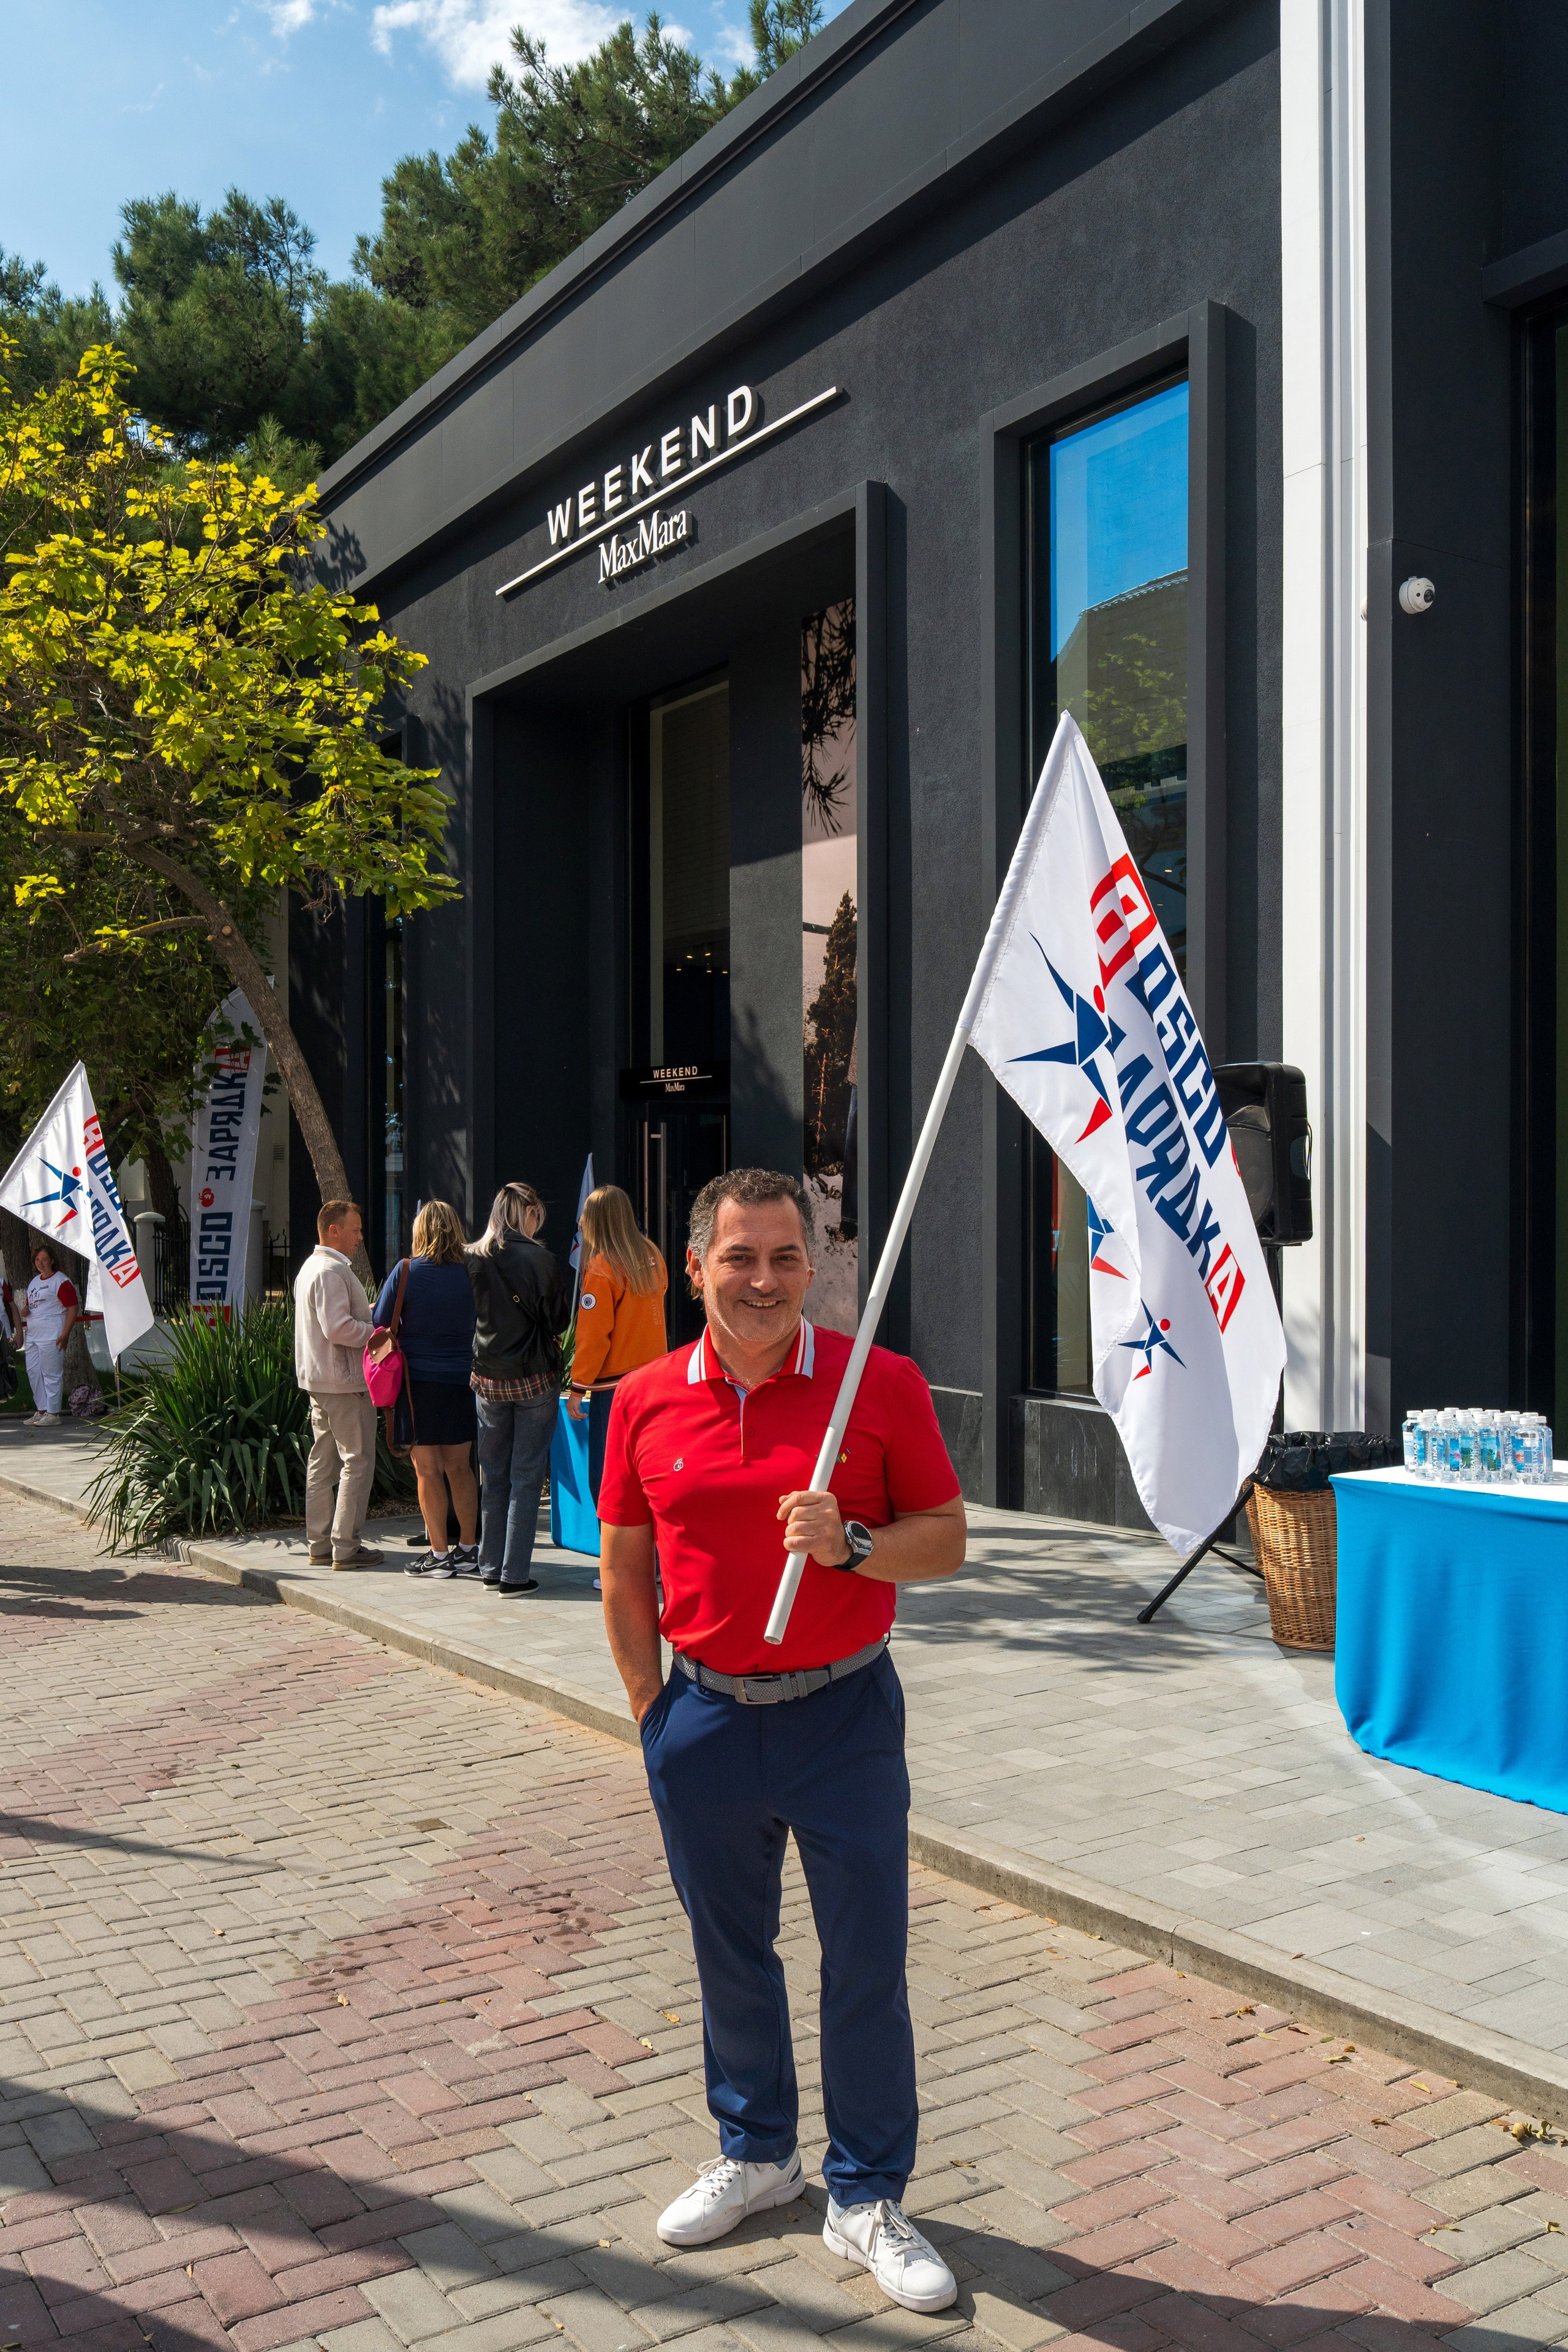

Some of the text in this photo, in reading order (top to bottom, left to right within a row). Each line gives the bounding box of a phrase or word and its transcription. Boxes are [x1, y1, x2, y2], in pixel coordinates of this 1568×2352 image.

[546, 385, 758, 546] WEEKEND
[598, 509, 692, 585] MaxMara
[653, 1066, 698, 1079] WEEKEND
[665, 1082, 685, 1092] MaxMara
[206, 1047, 251, 1181] ЗАРЯДКА
